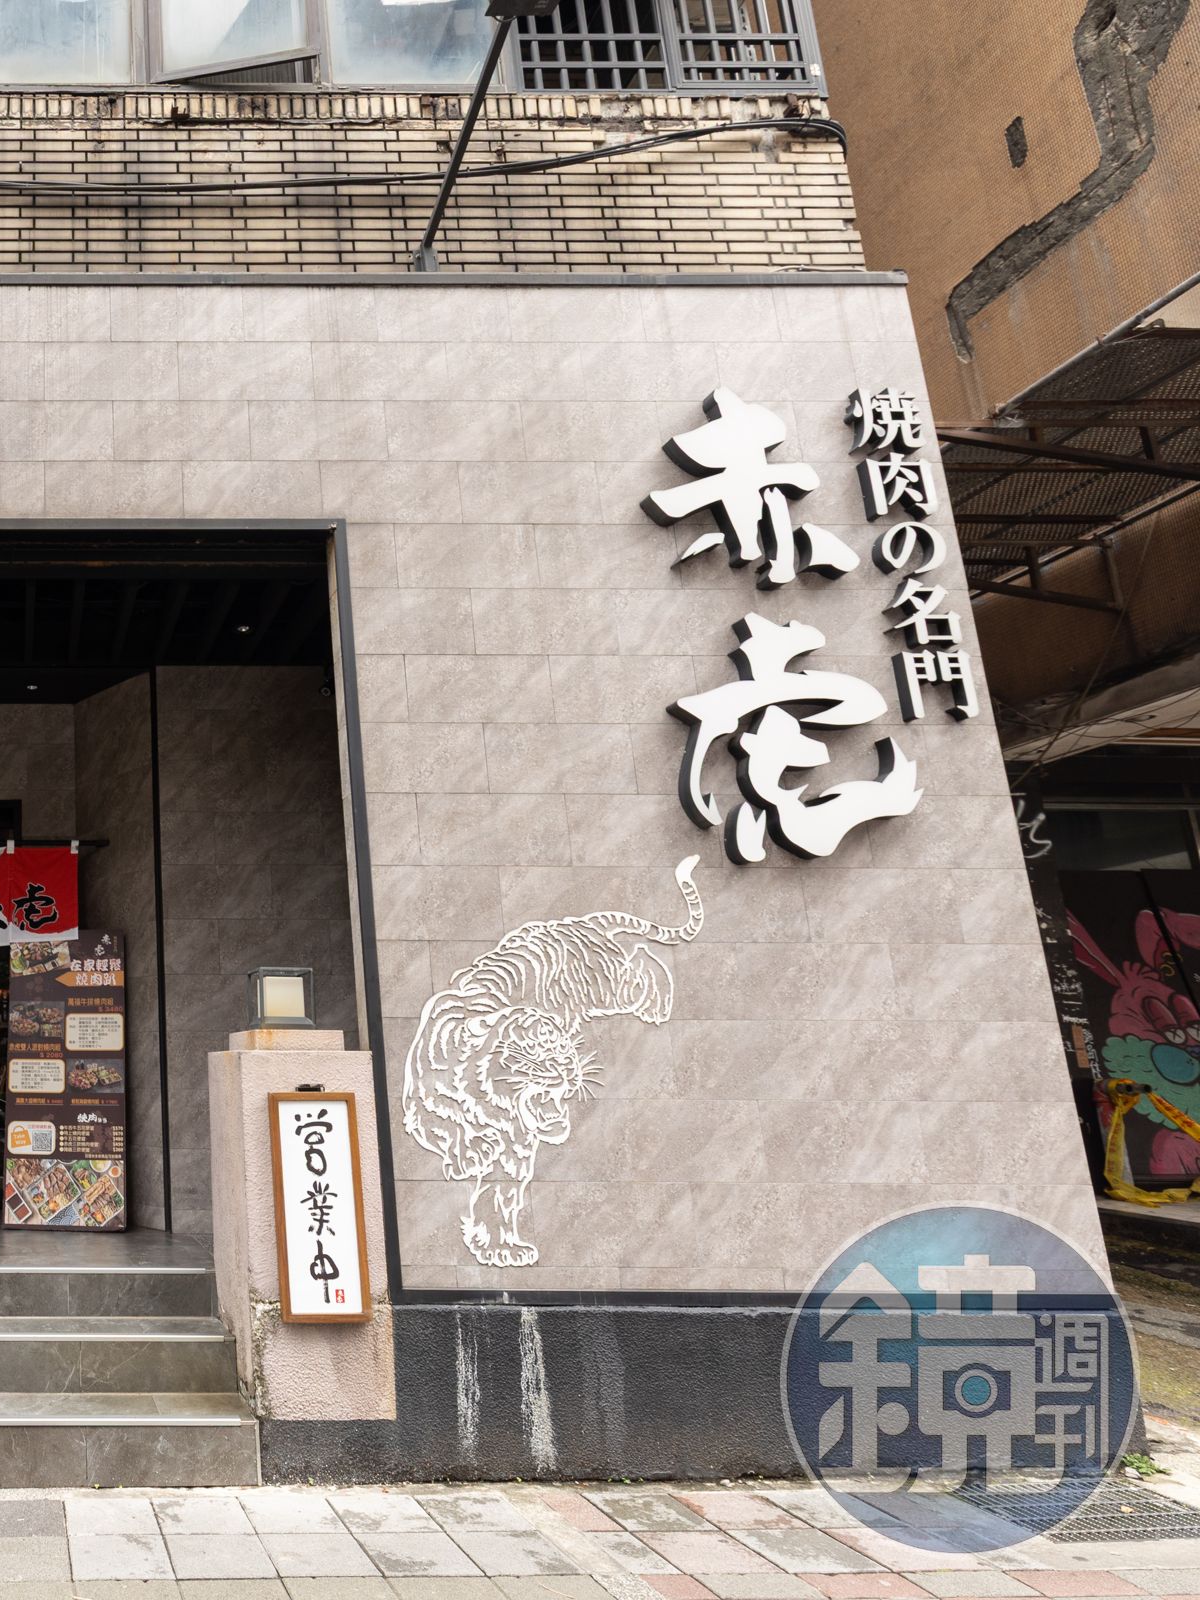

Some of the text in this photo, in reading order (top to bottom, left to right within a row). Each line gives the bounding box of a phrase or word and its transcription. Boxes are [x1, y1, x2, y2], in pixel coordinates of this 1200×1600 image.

[844, 387, 980, 723] 焼肉の名門
